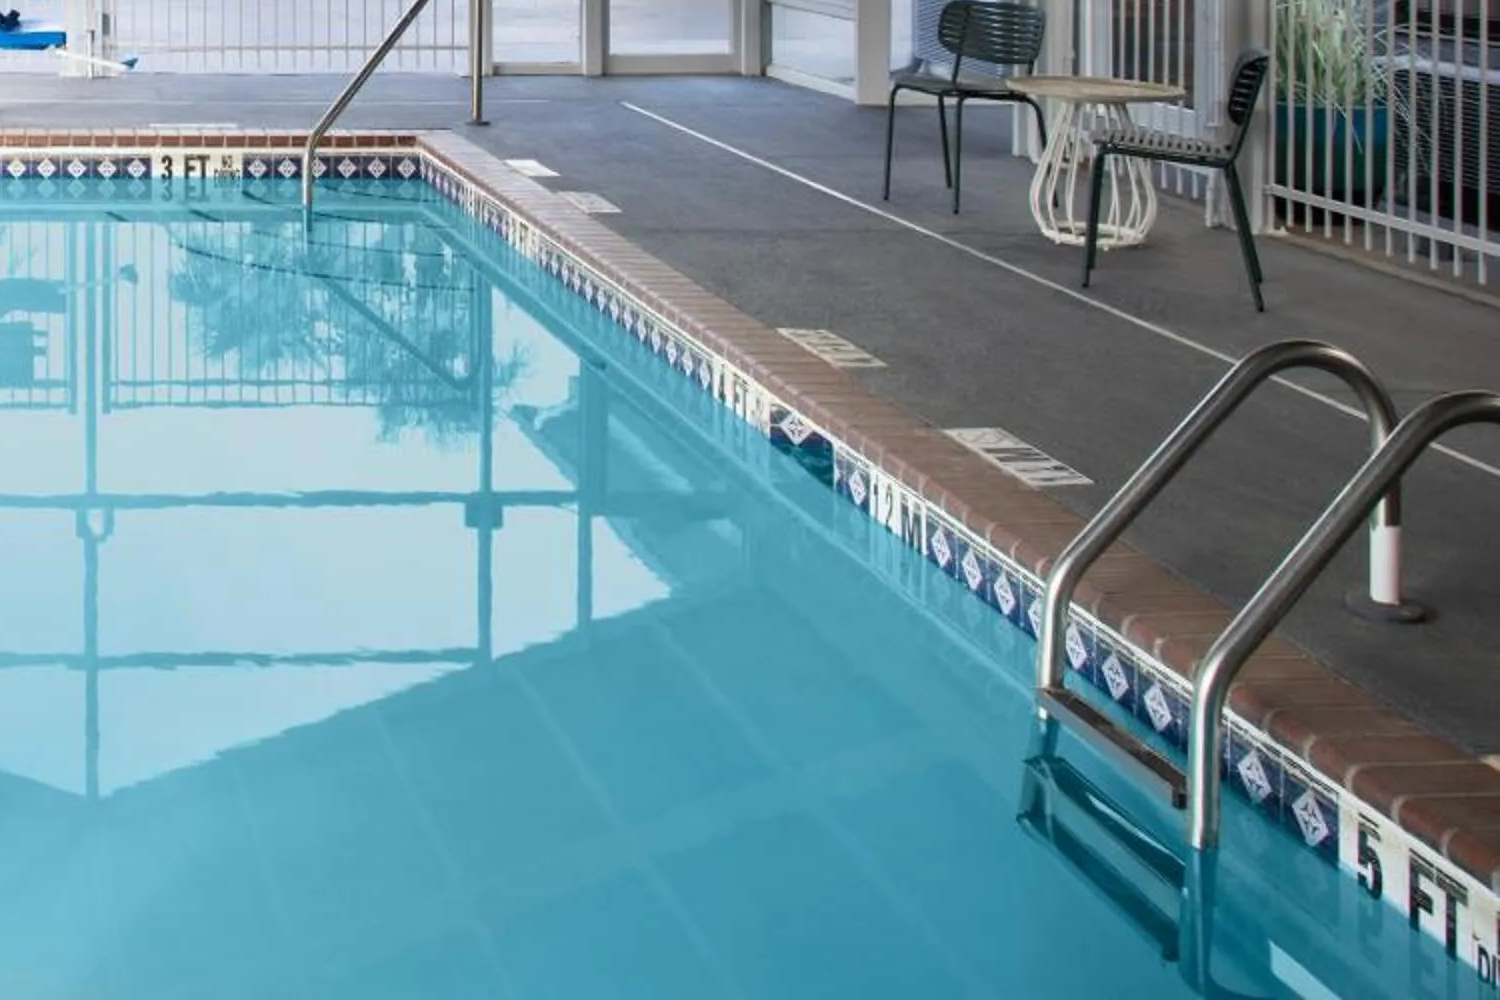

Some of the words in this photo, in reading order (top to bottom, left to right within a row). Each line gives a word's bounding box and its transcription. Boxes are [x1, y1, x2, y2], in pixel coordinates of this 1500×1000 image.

[161, 154, 173, 180] 3
[184, 154, 210, 180] FT
[1356, 811, 1383, 900] 5
[1408, 847, 1468, 962] FT
